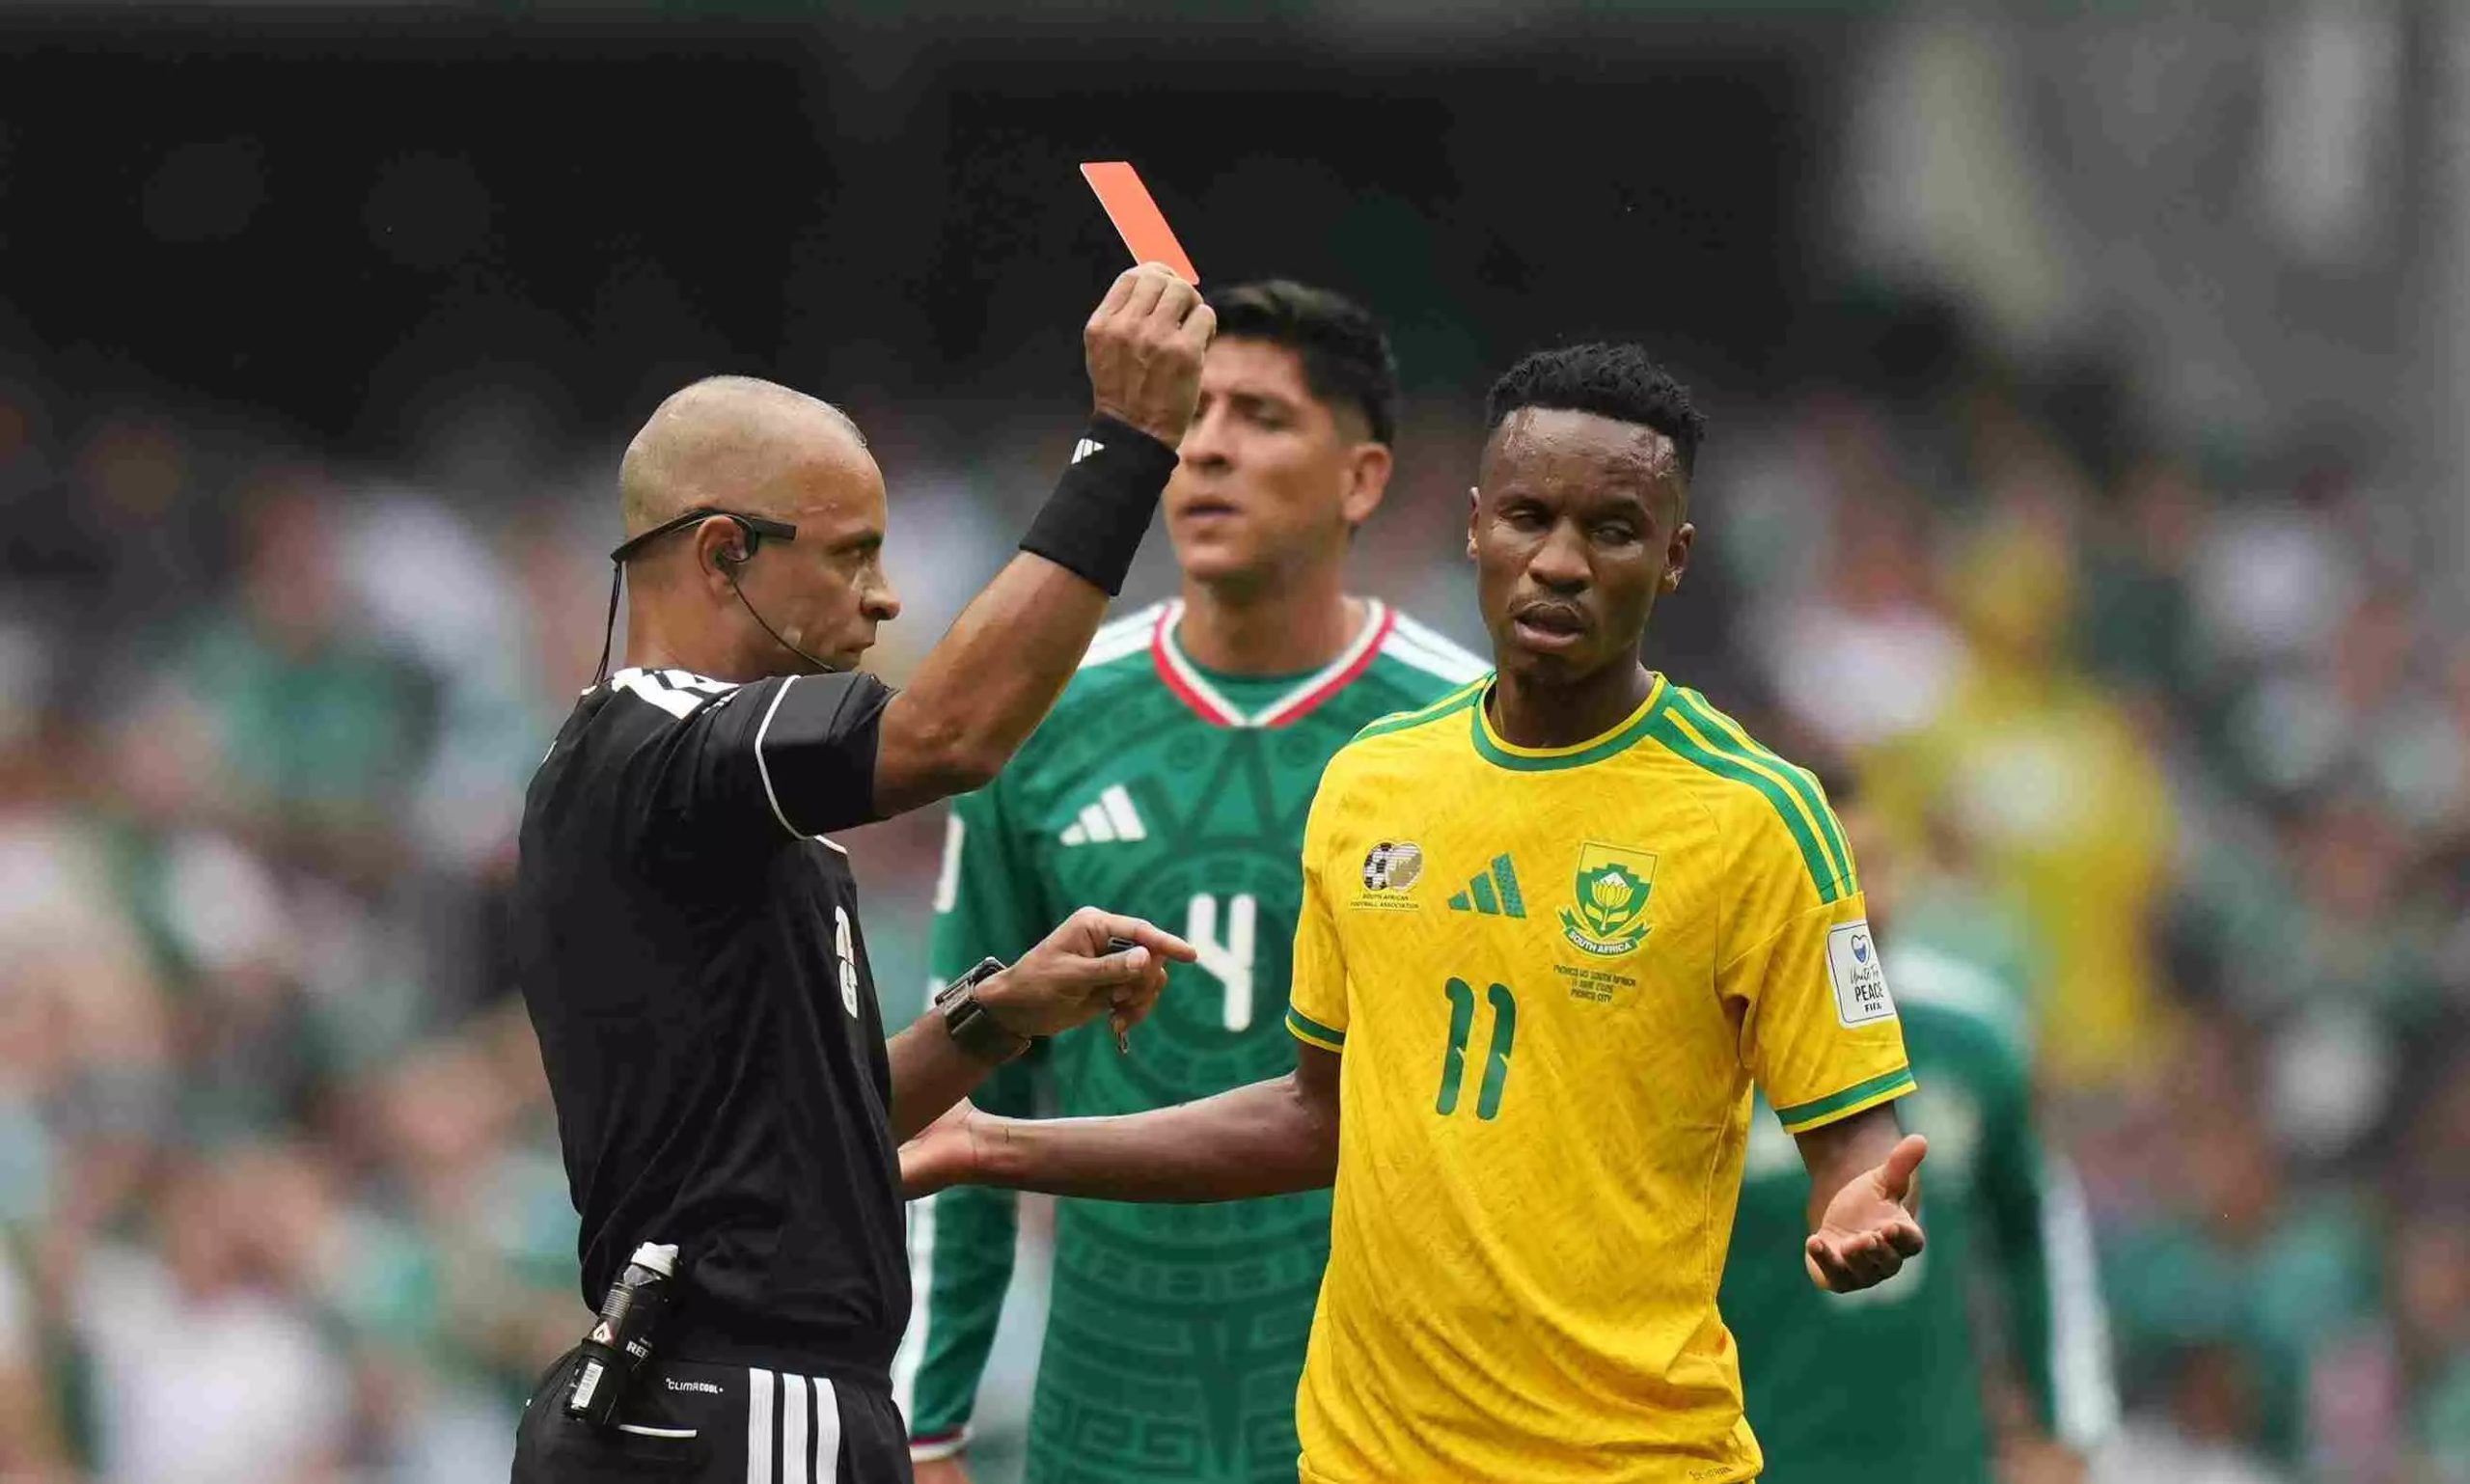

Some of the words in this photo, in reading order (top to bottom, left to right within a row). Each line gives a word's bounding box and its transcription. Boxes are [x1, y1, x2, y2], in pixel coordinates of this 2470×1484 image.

[1568, 930, 1598, 952] SOUTH
[1597, 941, 1633, 954] AFRICA
[1187, 893, 1256, 1032] 4
[1853, 980, 1884, 1003] PEACE
[1864, 1002, 1882, 1013] FIFA
[1435, 976, 1518, 1121] 11
